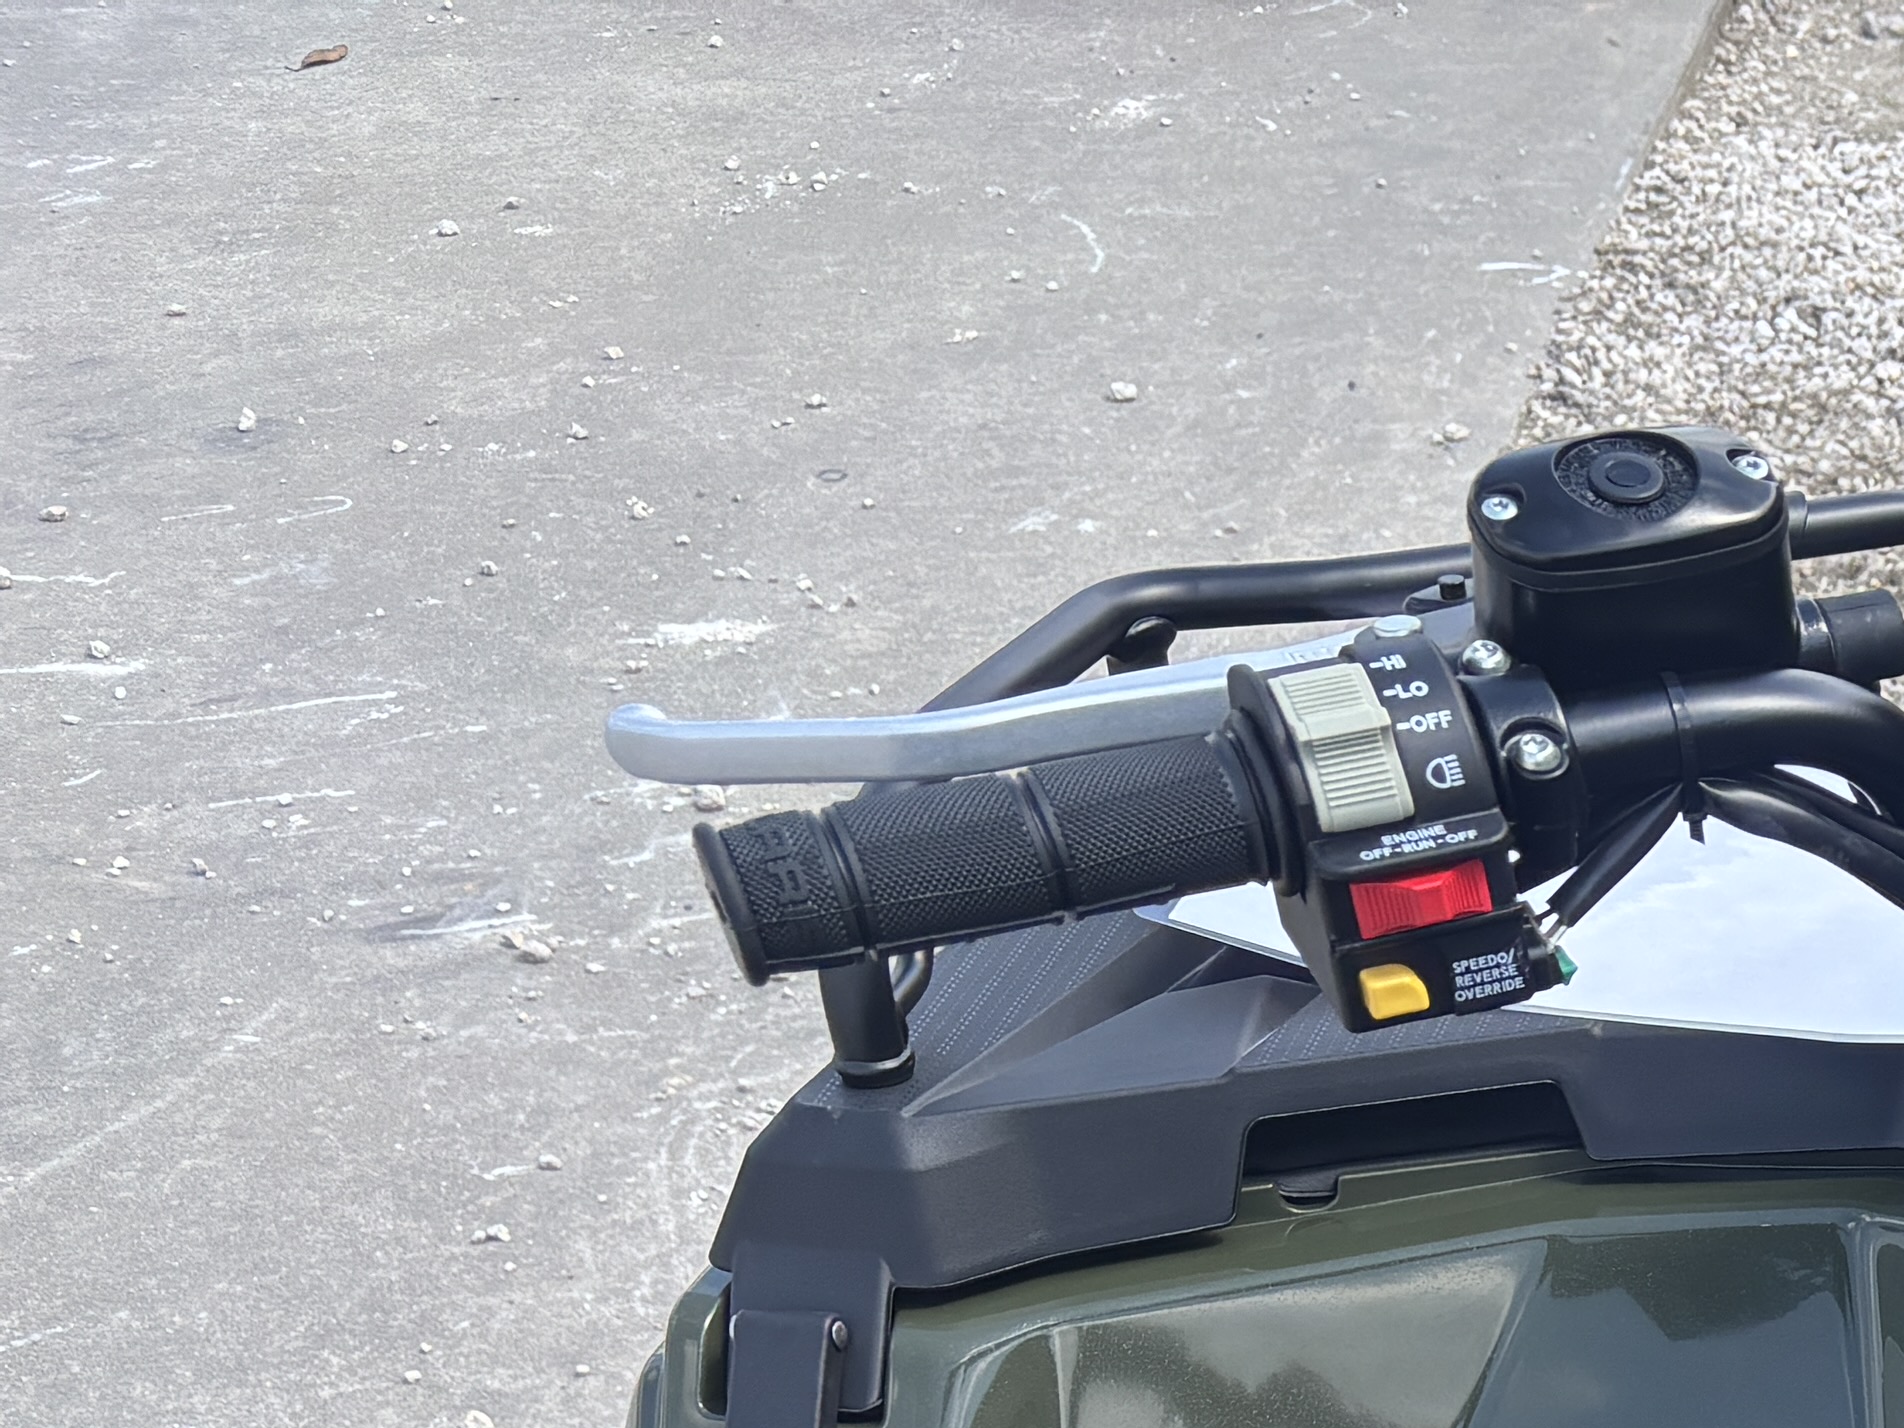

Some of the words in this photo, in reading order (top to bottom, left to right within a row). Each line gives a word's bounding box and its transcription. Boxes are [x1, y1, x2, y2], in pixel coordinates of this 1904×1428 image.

[1394, 680, 1429, 699] LO
[1409, 709, 1453, 733] OFF
[1380, 824, 1448, 846] ENGINE
[1452, 948, 1515, 973] SPEEDO/
[1455, 964, 1519, 988] REVERSE
[1455, 976, 1525, 1002] OVERRIDE
